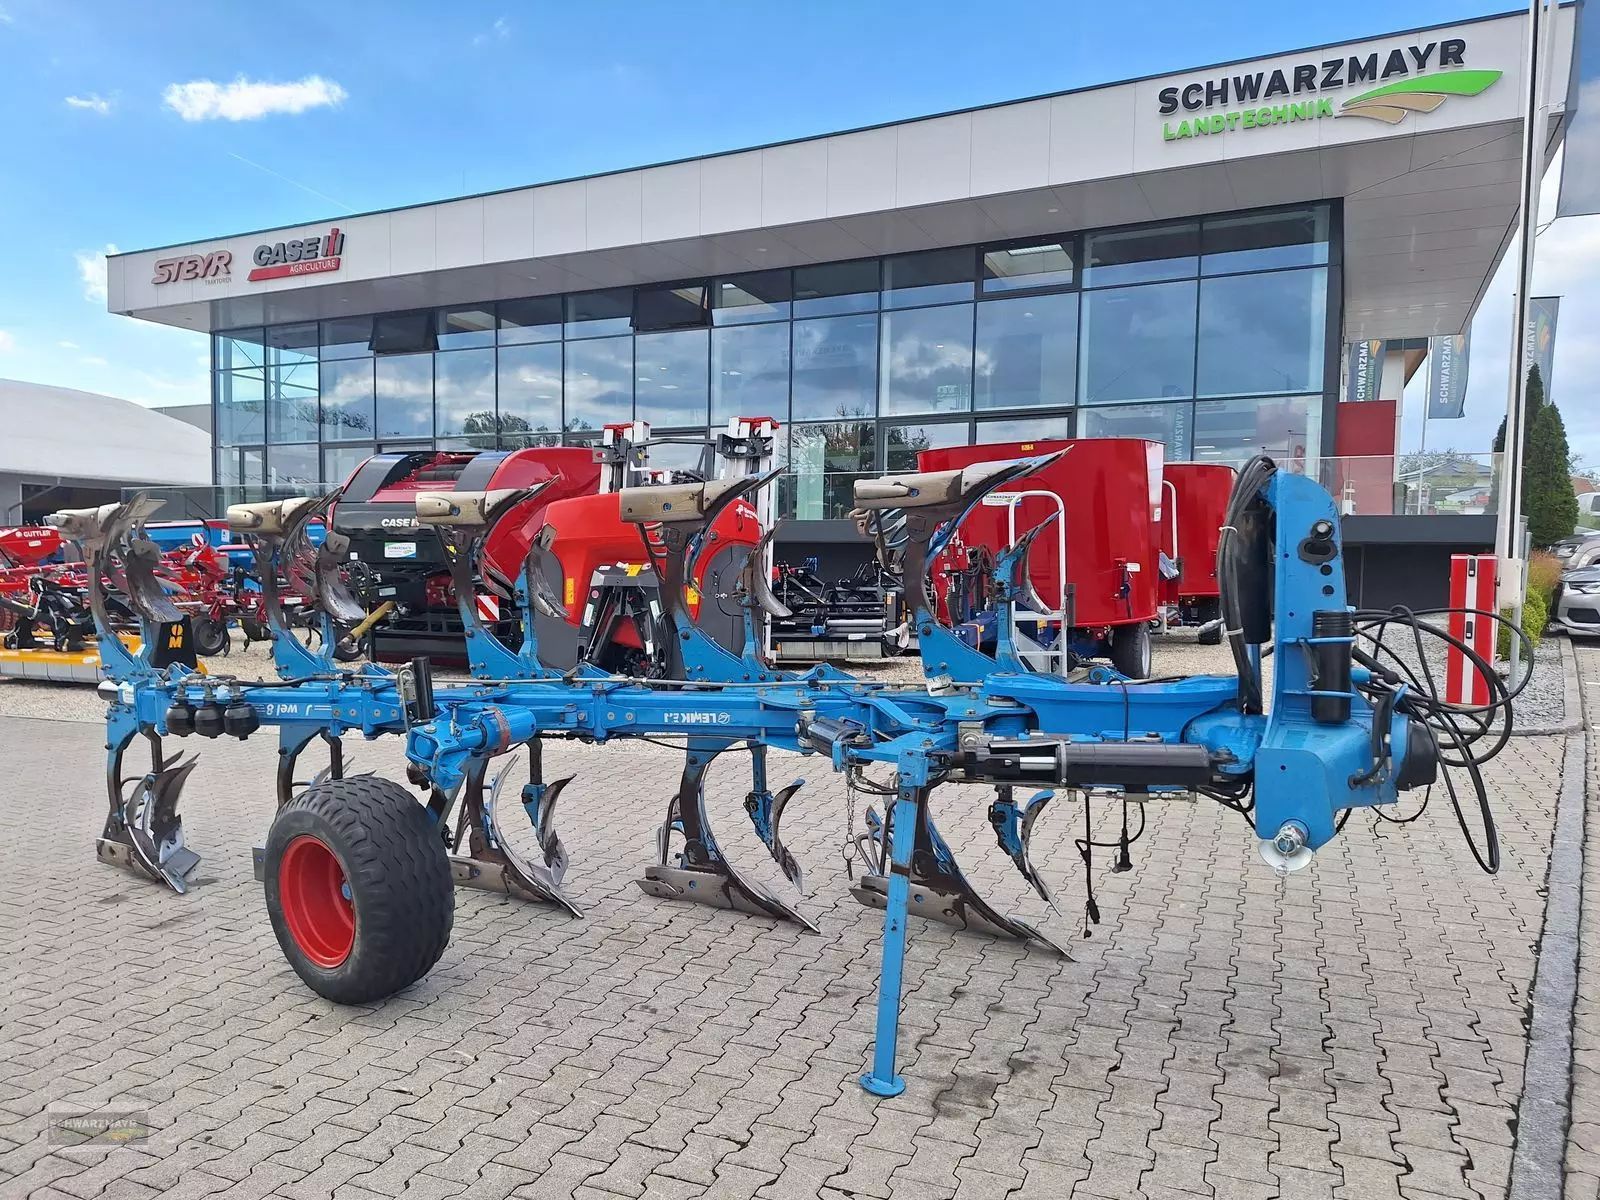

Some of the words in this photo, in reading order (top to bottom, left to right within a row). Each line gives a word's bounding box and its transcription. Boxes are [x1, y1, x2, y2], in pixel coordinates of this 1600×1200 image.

[1158, 38, 1467, 115] SCHWARZMAYR
[1163, 97, 1335, 141] LANDTECHNIK
[151, 250, 232, 284] STEYR
[253, 237, 320, 266] CASE
[289, 258, 336, 274] AGRICULTURE
[381, 518, 410, 527] CASE
